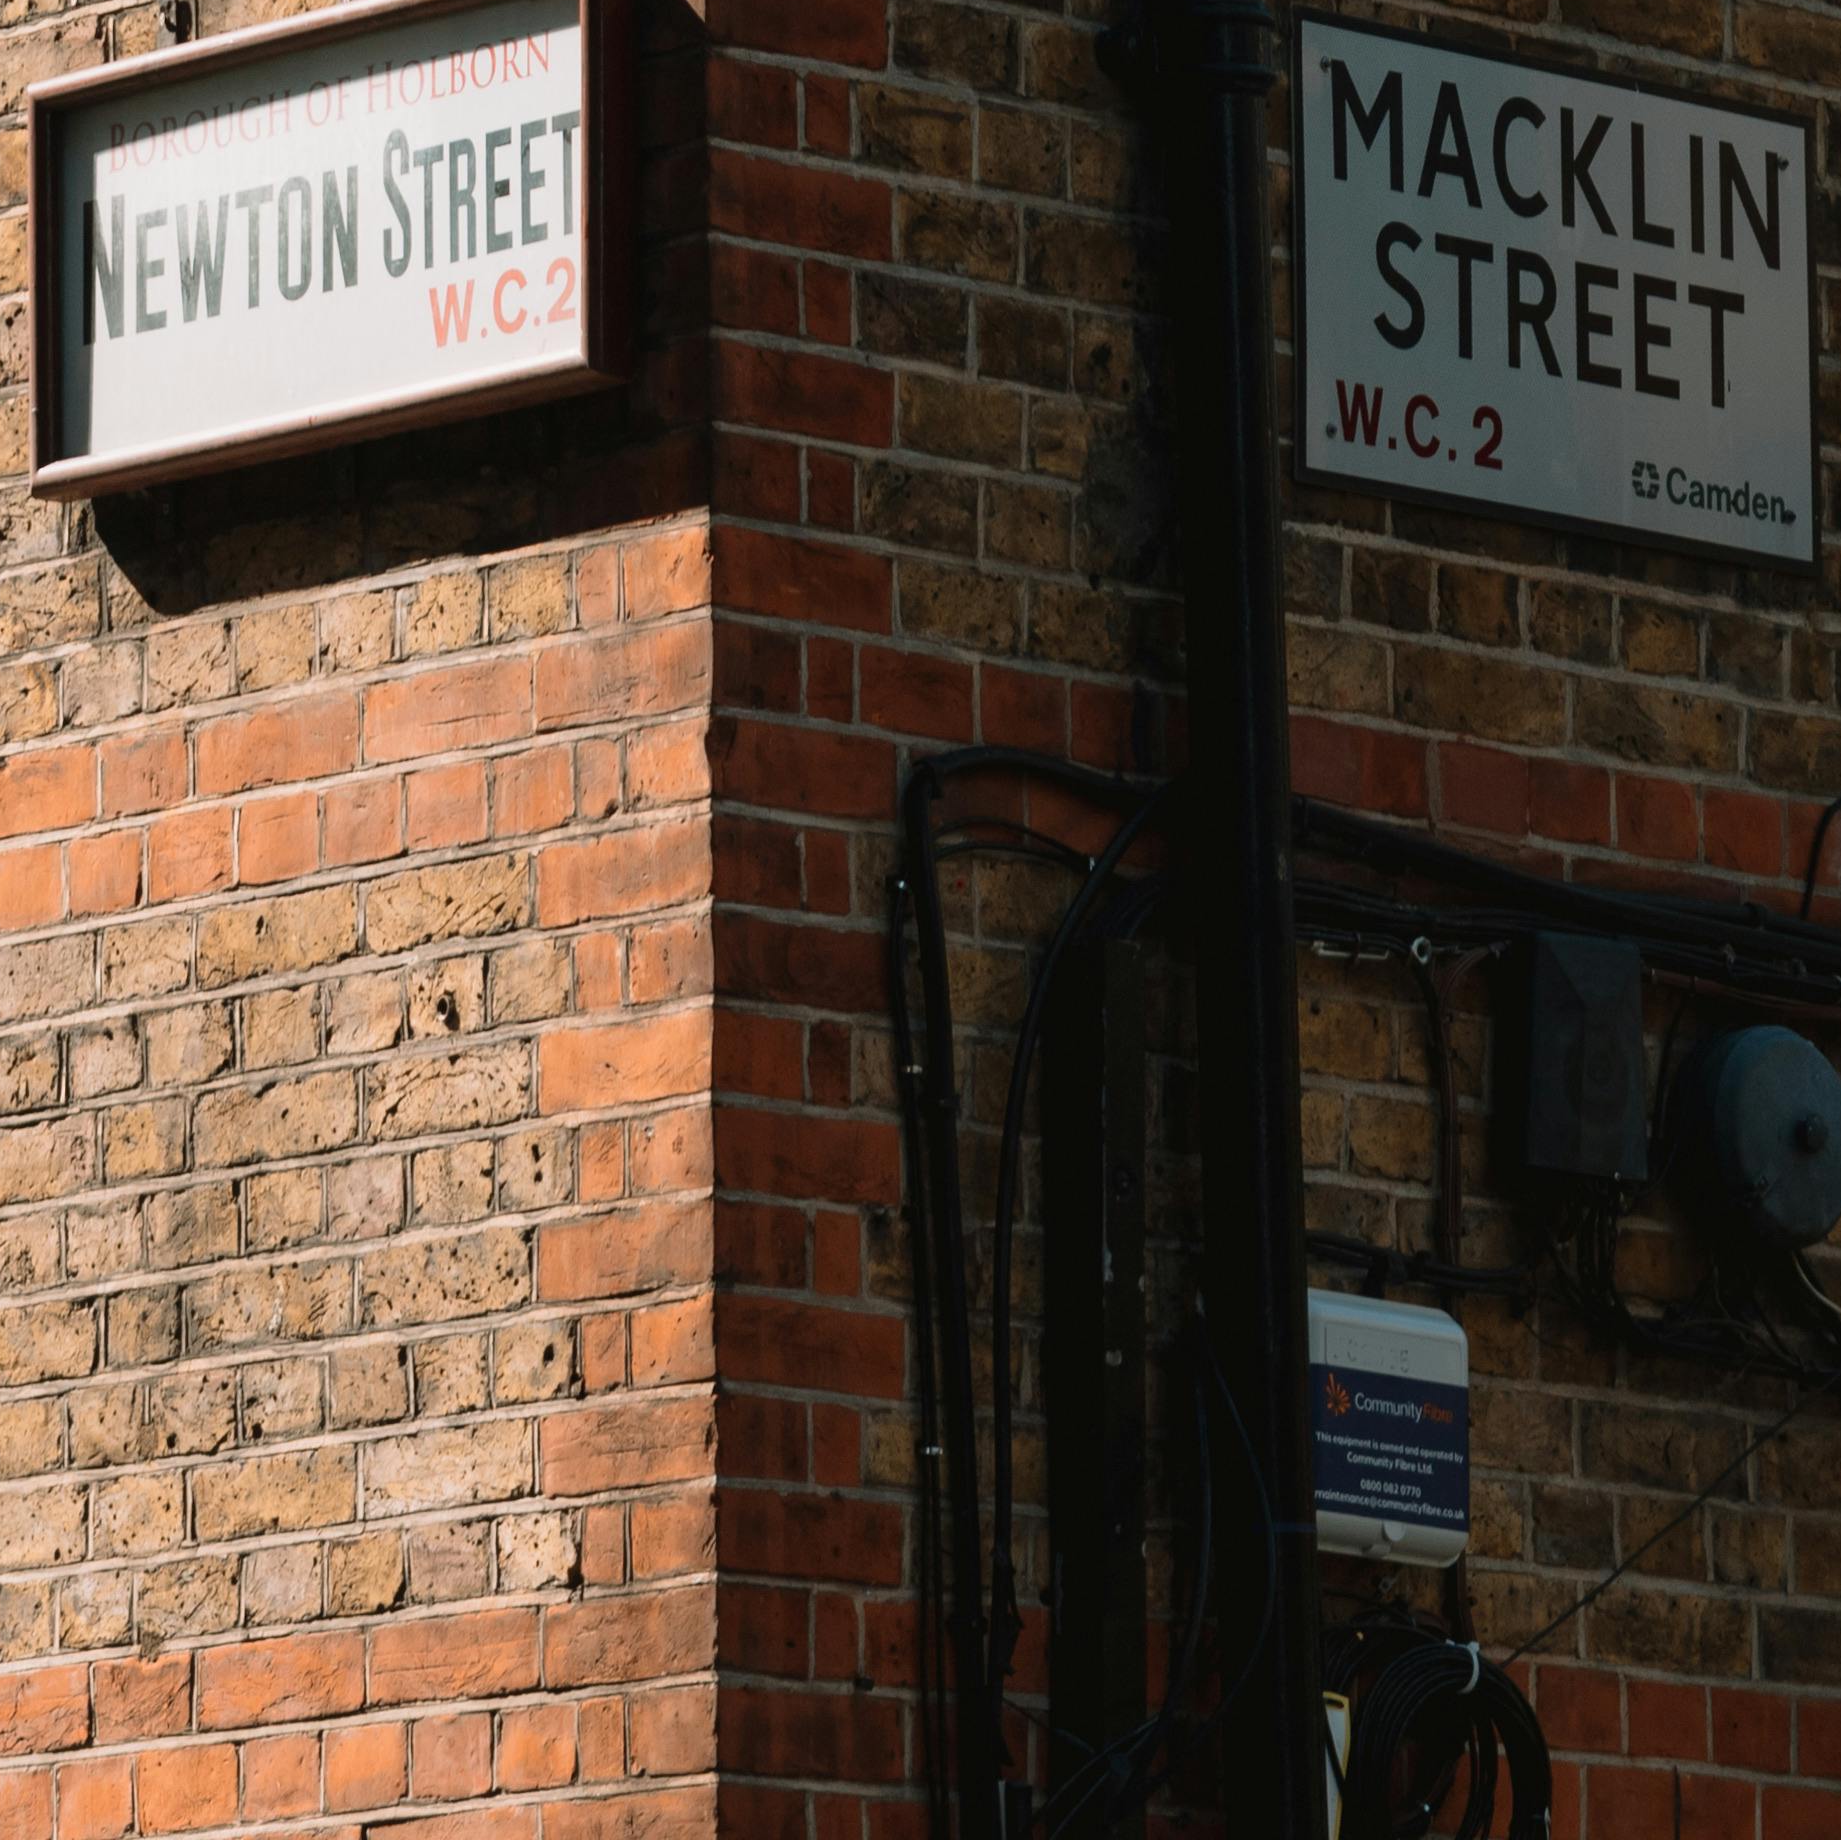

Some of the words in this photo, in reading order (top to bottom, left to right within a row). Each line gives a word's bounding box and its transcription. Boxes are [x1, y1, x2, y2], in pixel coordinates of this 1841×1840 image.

[108, 88, 292, 172] BOROUGH
[306, 77, 351, 127] OF
[366, 30, 551, 111] HOLBORN
[1330, 59, 1781, 270] MACKLIN
[83, 166, 358, 346] NEWTON
[383, 109, 580, 278] STREET
[429, 257, 576, 348] W.C.2
[1373, 221, 1745, 409] STREET
[1666, 467, 1786, 524] Camden
[1316, 1431, 1331, 1443] This
[1333, 1436, 1371, 1449] equipment
[1372, 1439, 1379, 1450] is
[1380, 1442, 1403, 1454] owned
[1405, 1445, 1419, 1456] and
[1420, 1448, 1453, 1462] operated
[1455, 1452, 1464, 1464] by
[1347, 1451, 1393, 1470] Community
[1395, 1458, 1416, 1471] Fibre
[1418, 1462, 1434, 1474] Ltd.
[1360, 1478, 1381, 1492] 0800
[1401, 1484, 1421, 1498] 0770
